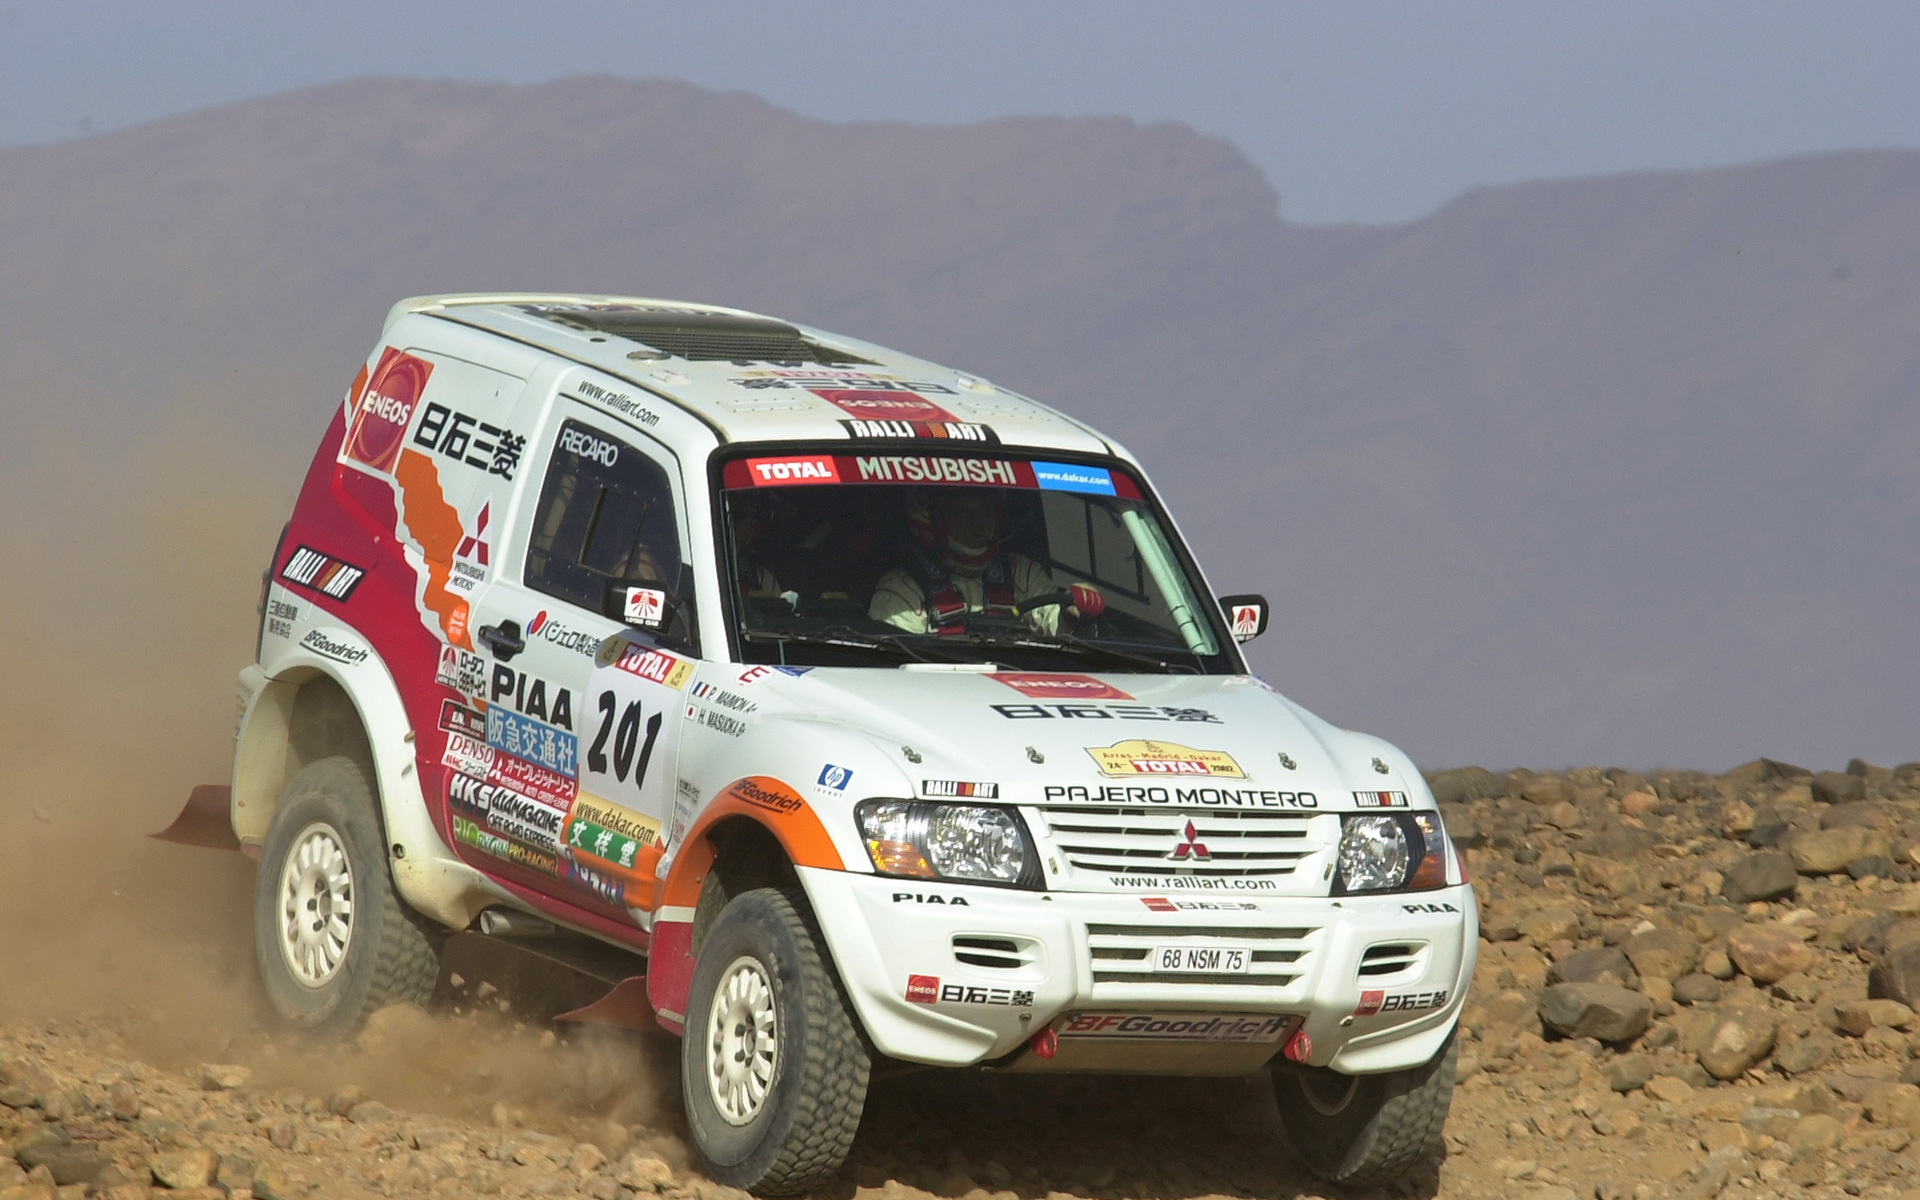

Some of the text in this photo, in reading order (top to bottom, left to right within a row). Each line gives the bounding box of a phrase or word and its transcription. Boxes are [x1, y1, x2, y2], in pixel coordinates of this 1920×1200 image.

[362, 390, 411, 426] ENEOS
[578, 380, 661, 427] www.ralliart.com
[413, 401, 526, 482] 日石三菱
[852, 421, 987, 441] RALLI ART
[559, 428, 618, 467] RECARO
[756, 462, 832, 480] TOTAL
[855, 456, 1017, 484] MITSUBISHI
[1038, 470, 1109, 486] www.dakar.com
[282, 547, 362, 598] RALLI ART
[304, 629, 368, 663] BFGoodrich
[620, 644, 670, 682] TOTAL
[1007, 680, 1106, 690] ENEOS
[491, 663, 573, 732] PIAA
[989, 704, 1225, 724] 日石三菱
[450, 735, 493, 764] DENSO
[488, 708, 575, 775] 阪急交通社
[588, 690, 662, 790] 201
[1133, 761, 1208, 773] TOTAL
[450, 773, 494, 810] HKS
[734, 779, 803, 811] BFGoodrich
[813, 786, 842, 799] invent
[926, 781, 995, 798] RALLI ART
[1044, 786, 1318, 808] PAJERO MONTERO
[577, 802, 655, 844] www.dakar.com
[1110, 876, 1277, 890] www.ralliart.com
[893, 893, 969, 907] PIAA
[1402, 904, 1460, 914] PIAA
[1163, 949, 1242, 970] 68 NSM 75
[909, 985, 937, 995] ENEOS
[941, 984, 1036, 1007] 日石三菱
[1381, 990, 1448, 1012] 日石三菱
[1067, 1014, 1290, 1035] BFGoodrich
